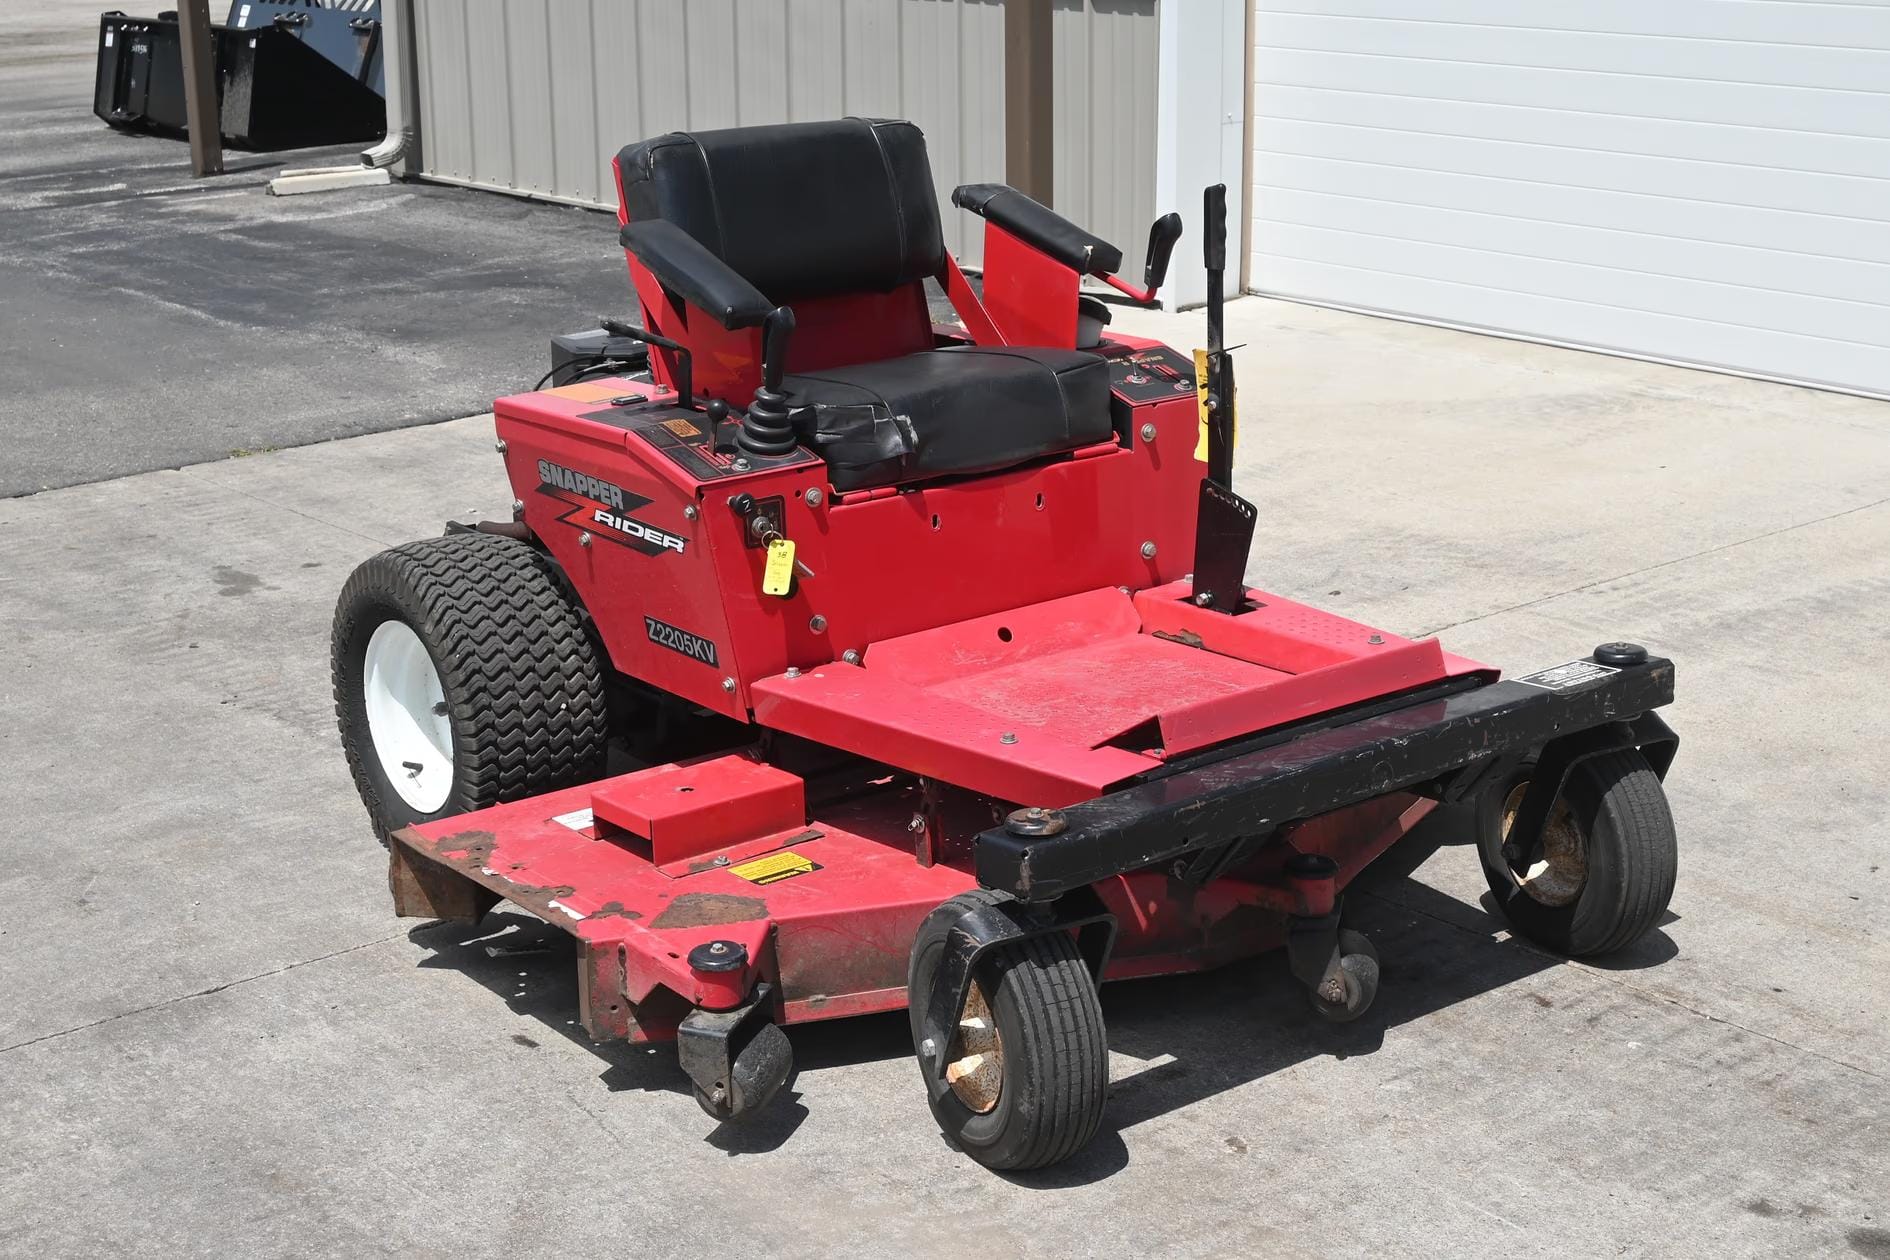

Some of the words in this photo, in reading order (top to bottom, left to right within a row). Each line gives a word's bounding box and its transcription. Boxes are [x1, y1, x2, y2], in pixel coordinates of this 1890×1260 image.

[537, 459, 624, 510] SNAPPER
[594, 509, 685, 554] RIDER
[645, 618, 714, 664] Z2205KV
